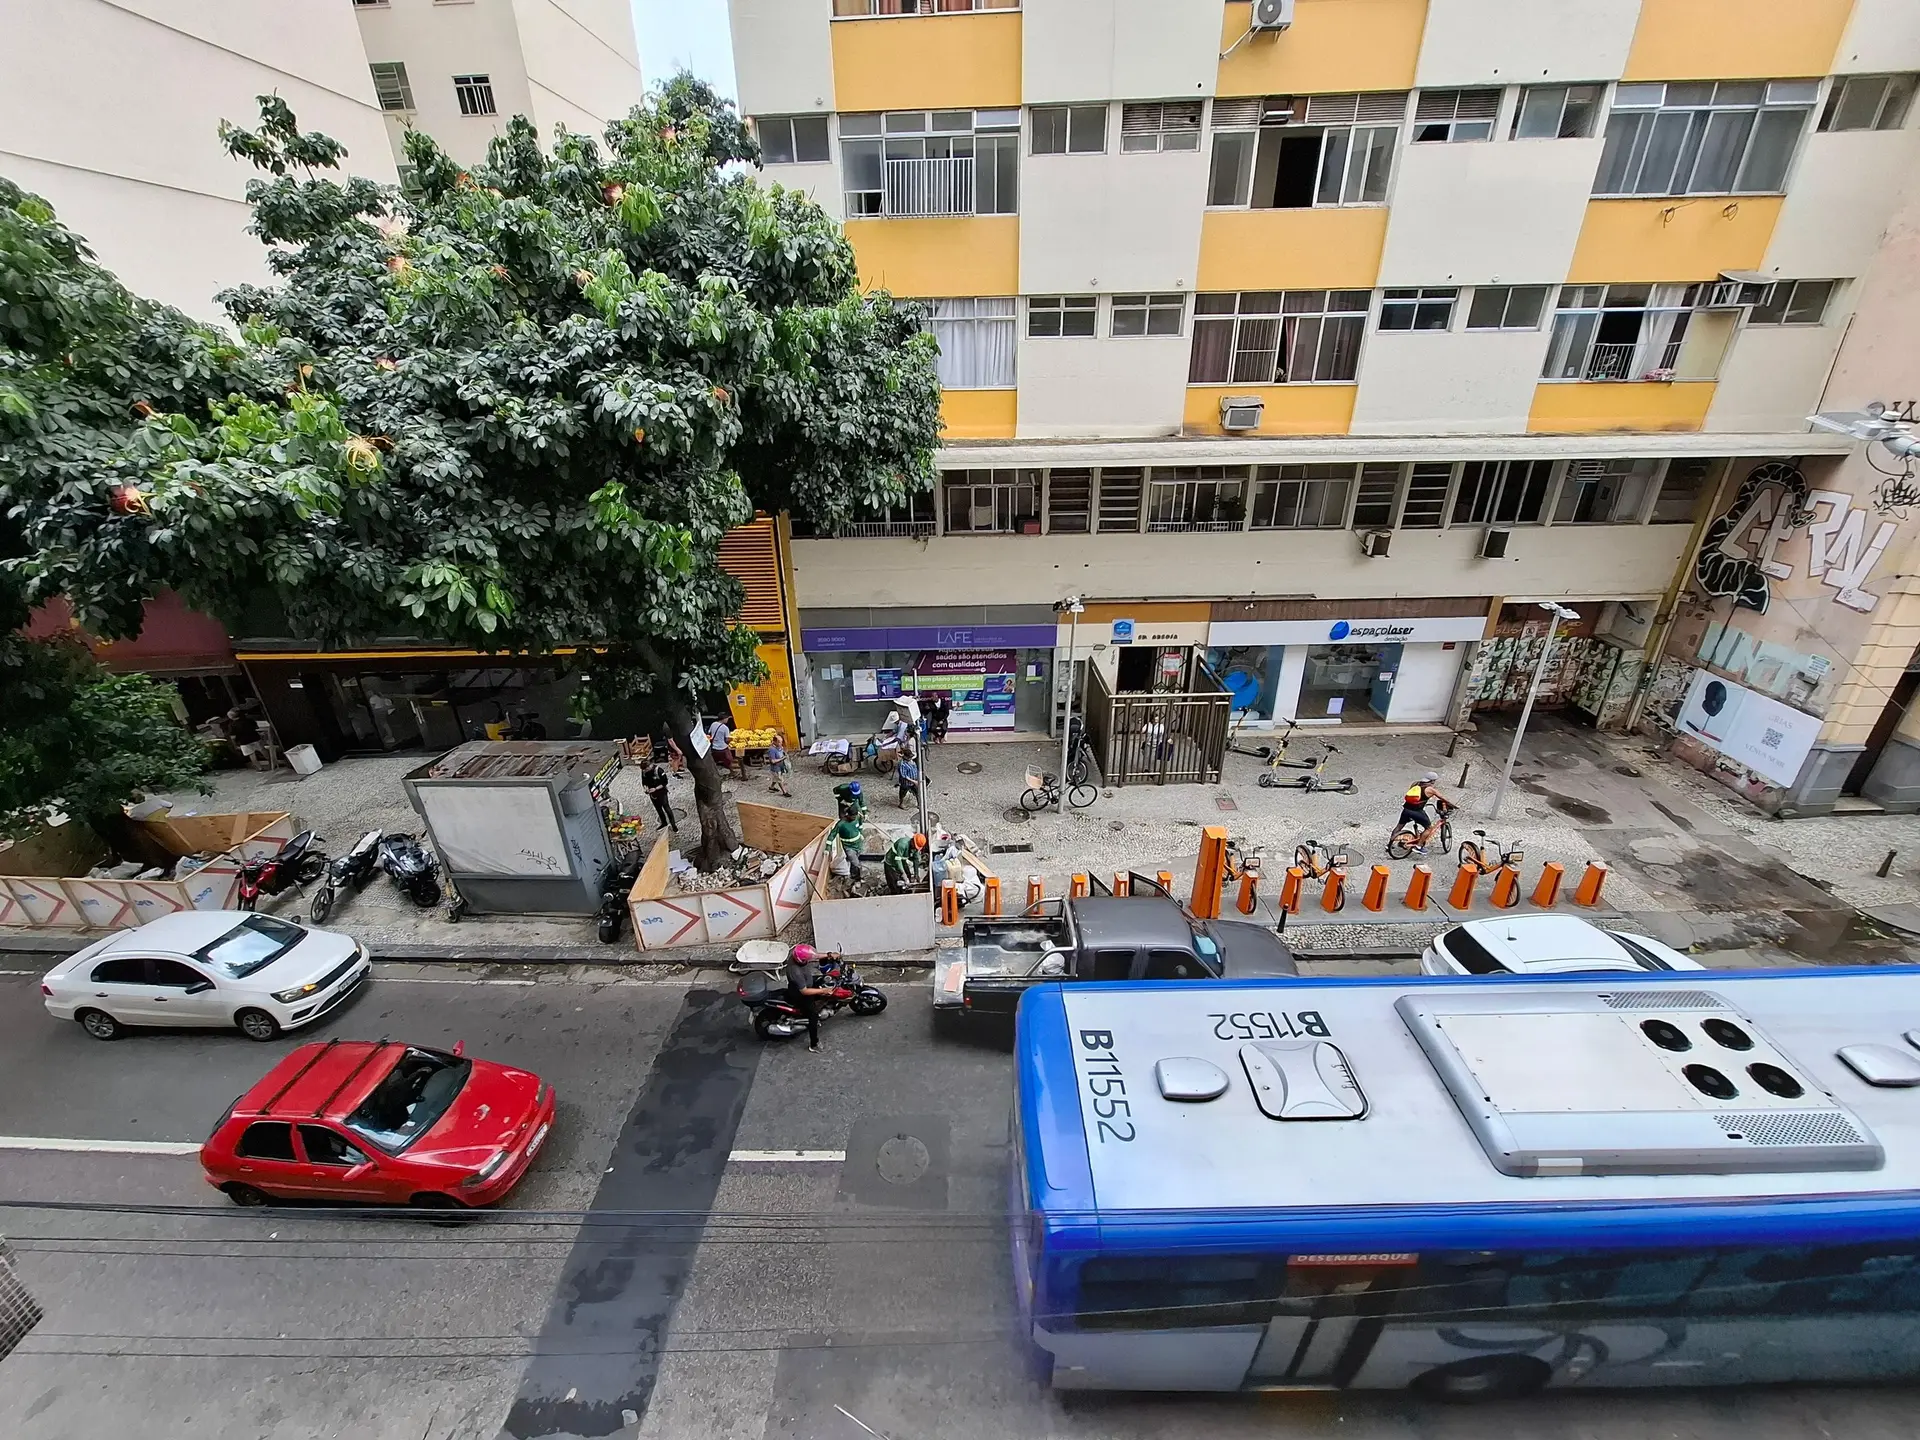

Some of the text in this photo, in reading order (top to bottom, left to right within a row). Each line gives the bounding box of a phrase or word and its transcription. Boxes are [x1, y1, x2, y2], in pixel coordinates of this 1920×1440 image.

[1351, 624, 1414, 637] espaçolaser
[937, 631, 972, 644] LAFE
[972, 652, 1007, 660] atendidos
[949, 660, 986, 668] qualidade!
[1206, 1011, 1332, 1040] B11552
[1080, 1030, 1136, 1144] B11552
[1297, 1253, 1410, 1262] DESEMBARQUE
